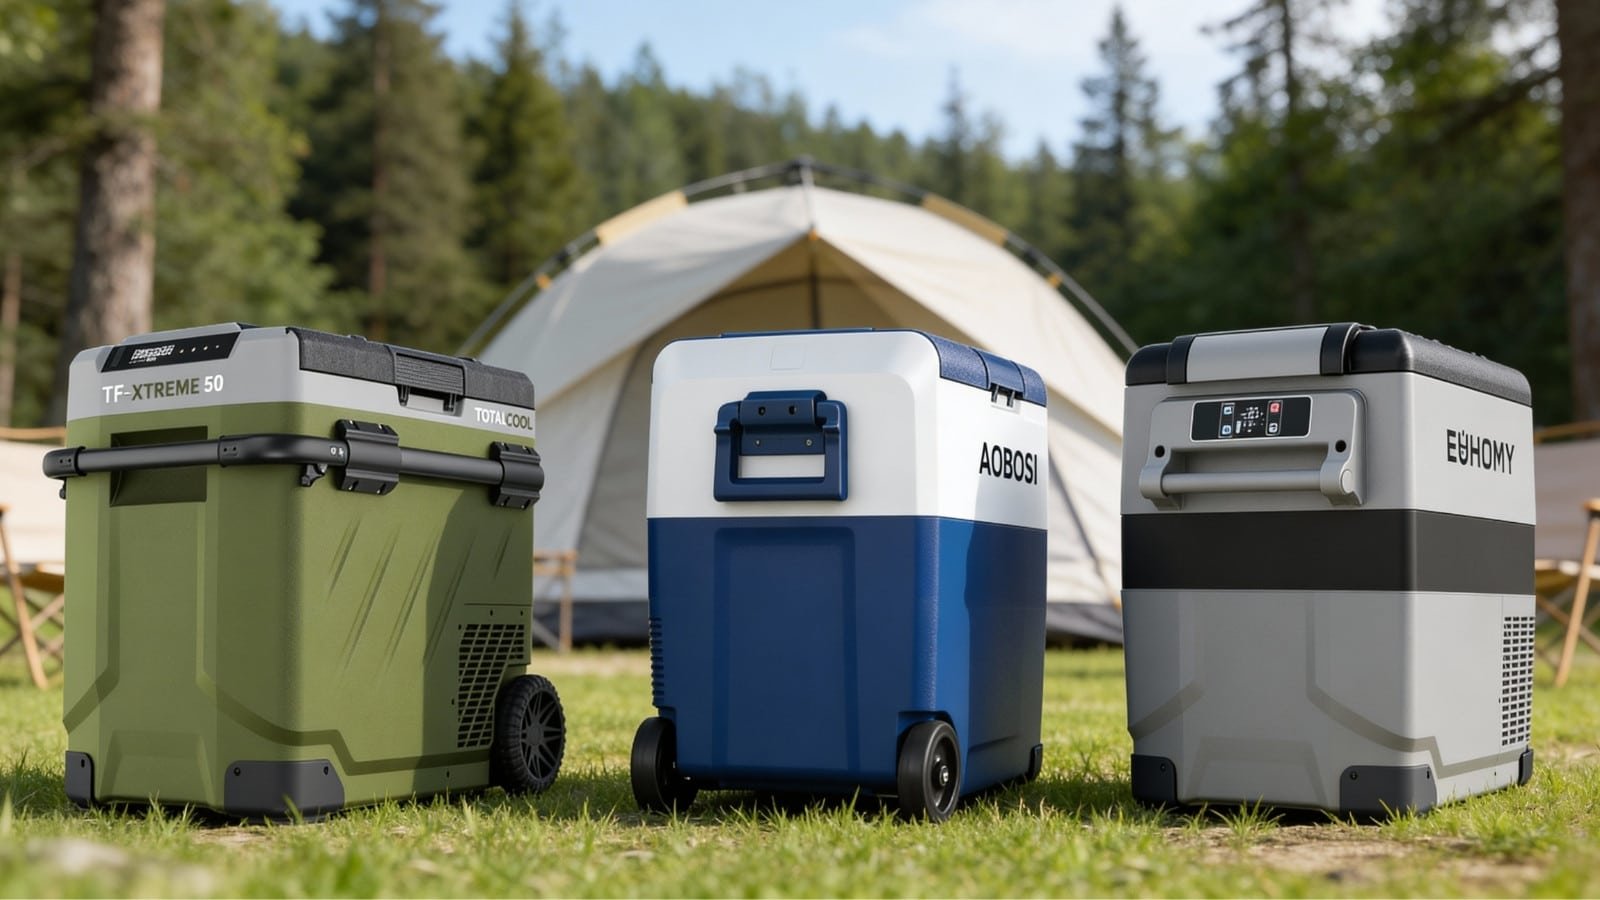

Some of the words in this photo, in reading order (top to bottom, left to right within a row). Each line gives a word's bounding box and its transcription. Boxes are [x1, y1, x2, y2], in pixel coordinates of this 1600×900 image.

[204, 374, 224, 393] 50
[474, 407, 533, 430] TOTALCOOL
[979, 441, 1037, 485] AOBOSI
